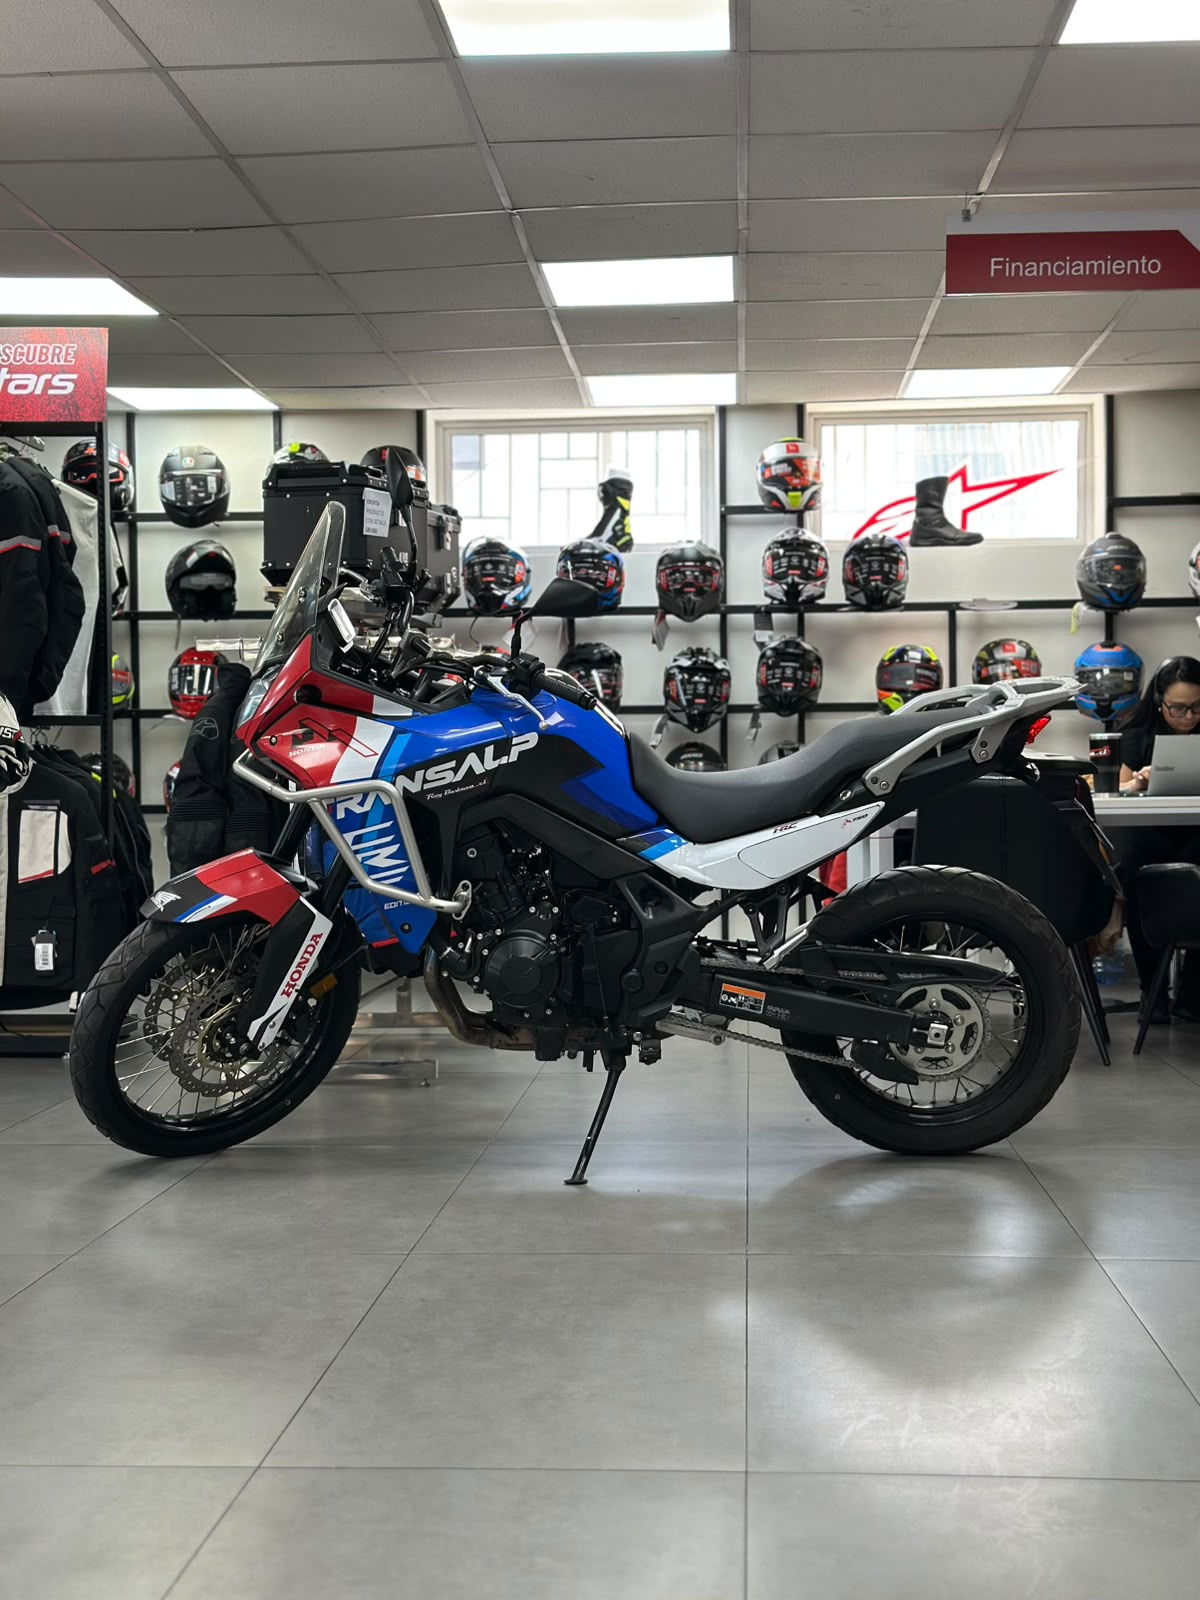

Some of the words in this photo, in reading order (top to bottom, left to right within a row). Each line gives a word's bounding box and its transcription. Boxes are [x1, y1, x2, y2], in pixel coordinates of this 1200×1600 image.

[990, 255, 1162, 277] Financiamiento
[0, 343, 77, 365] SCUBRE
[288, 743, 326, 757] HONDA
[280, 932, 324, 999] HONDA
